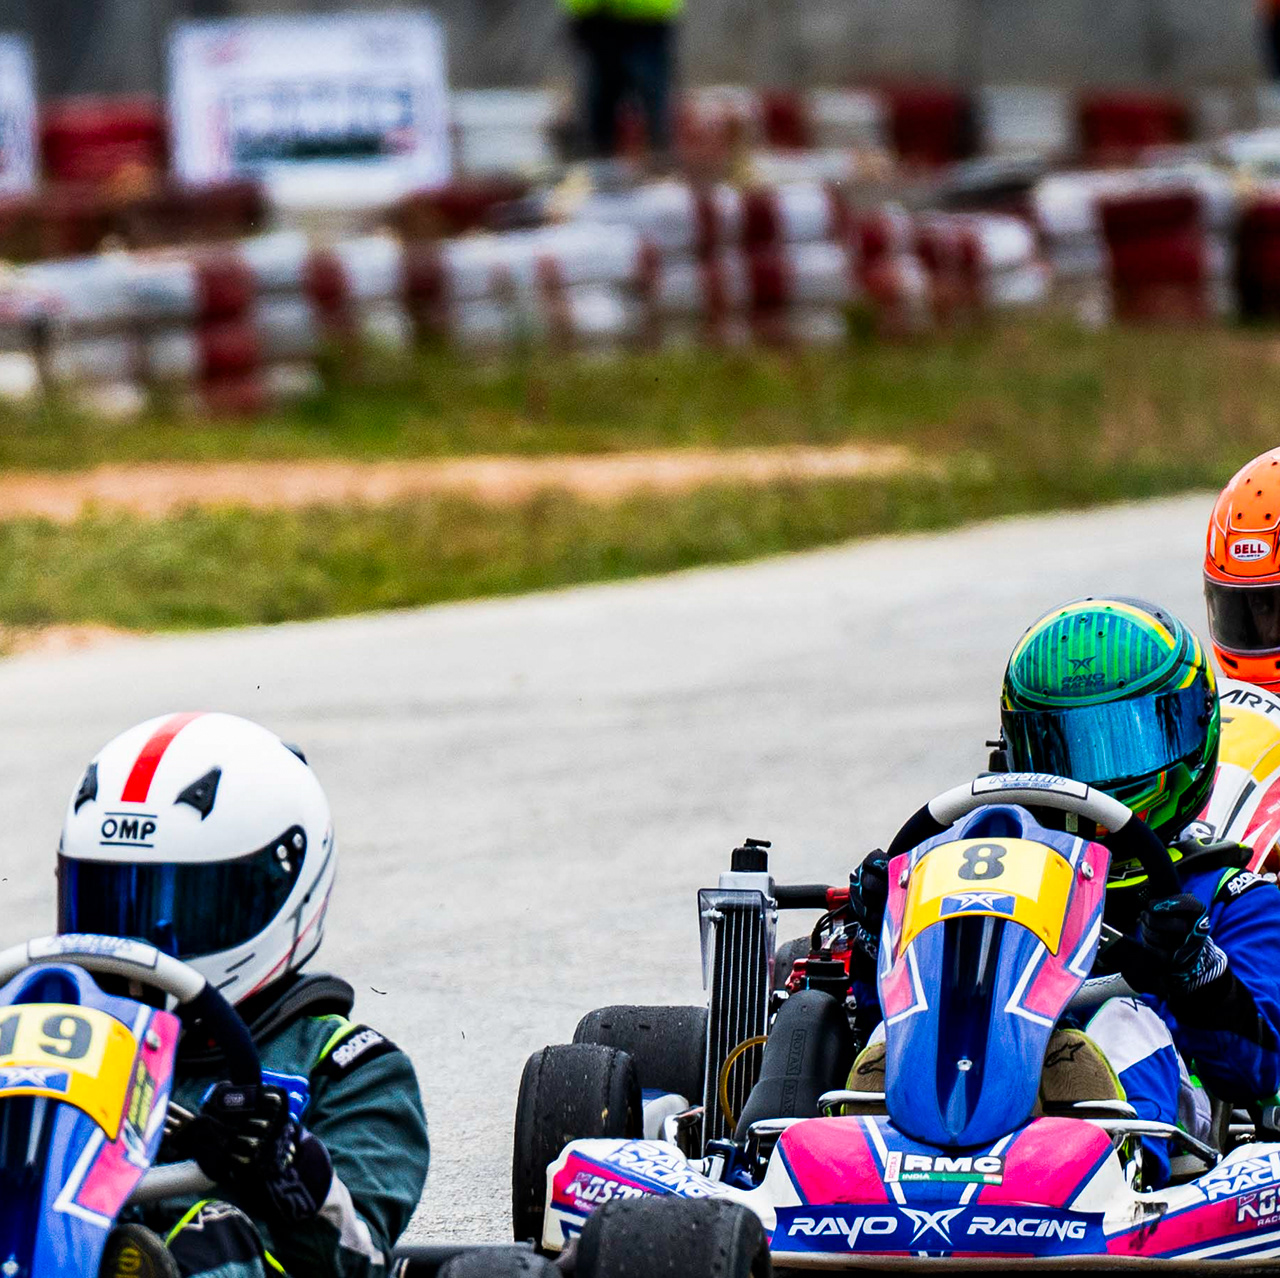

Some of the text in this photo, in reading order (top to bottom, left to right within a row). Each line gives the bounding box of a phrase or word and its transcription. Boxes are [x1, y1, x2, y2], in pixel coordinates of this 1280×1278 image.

[1234, 544, 1264, 554] BELL
[100, 819, 157, 840] OMP
[958, 843, 1008, 881] 8
[904, 1154, 1002, 1173] RMC
[788, 1216, 1087, 1249] RAYO RACING
